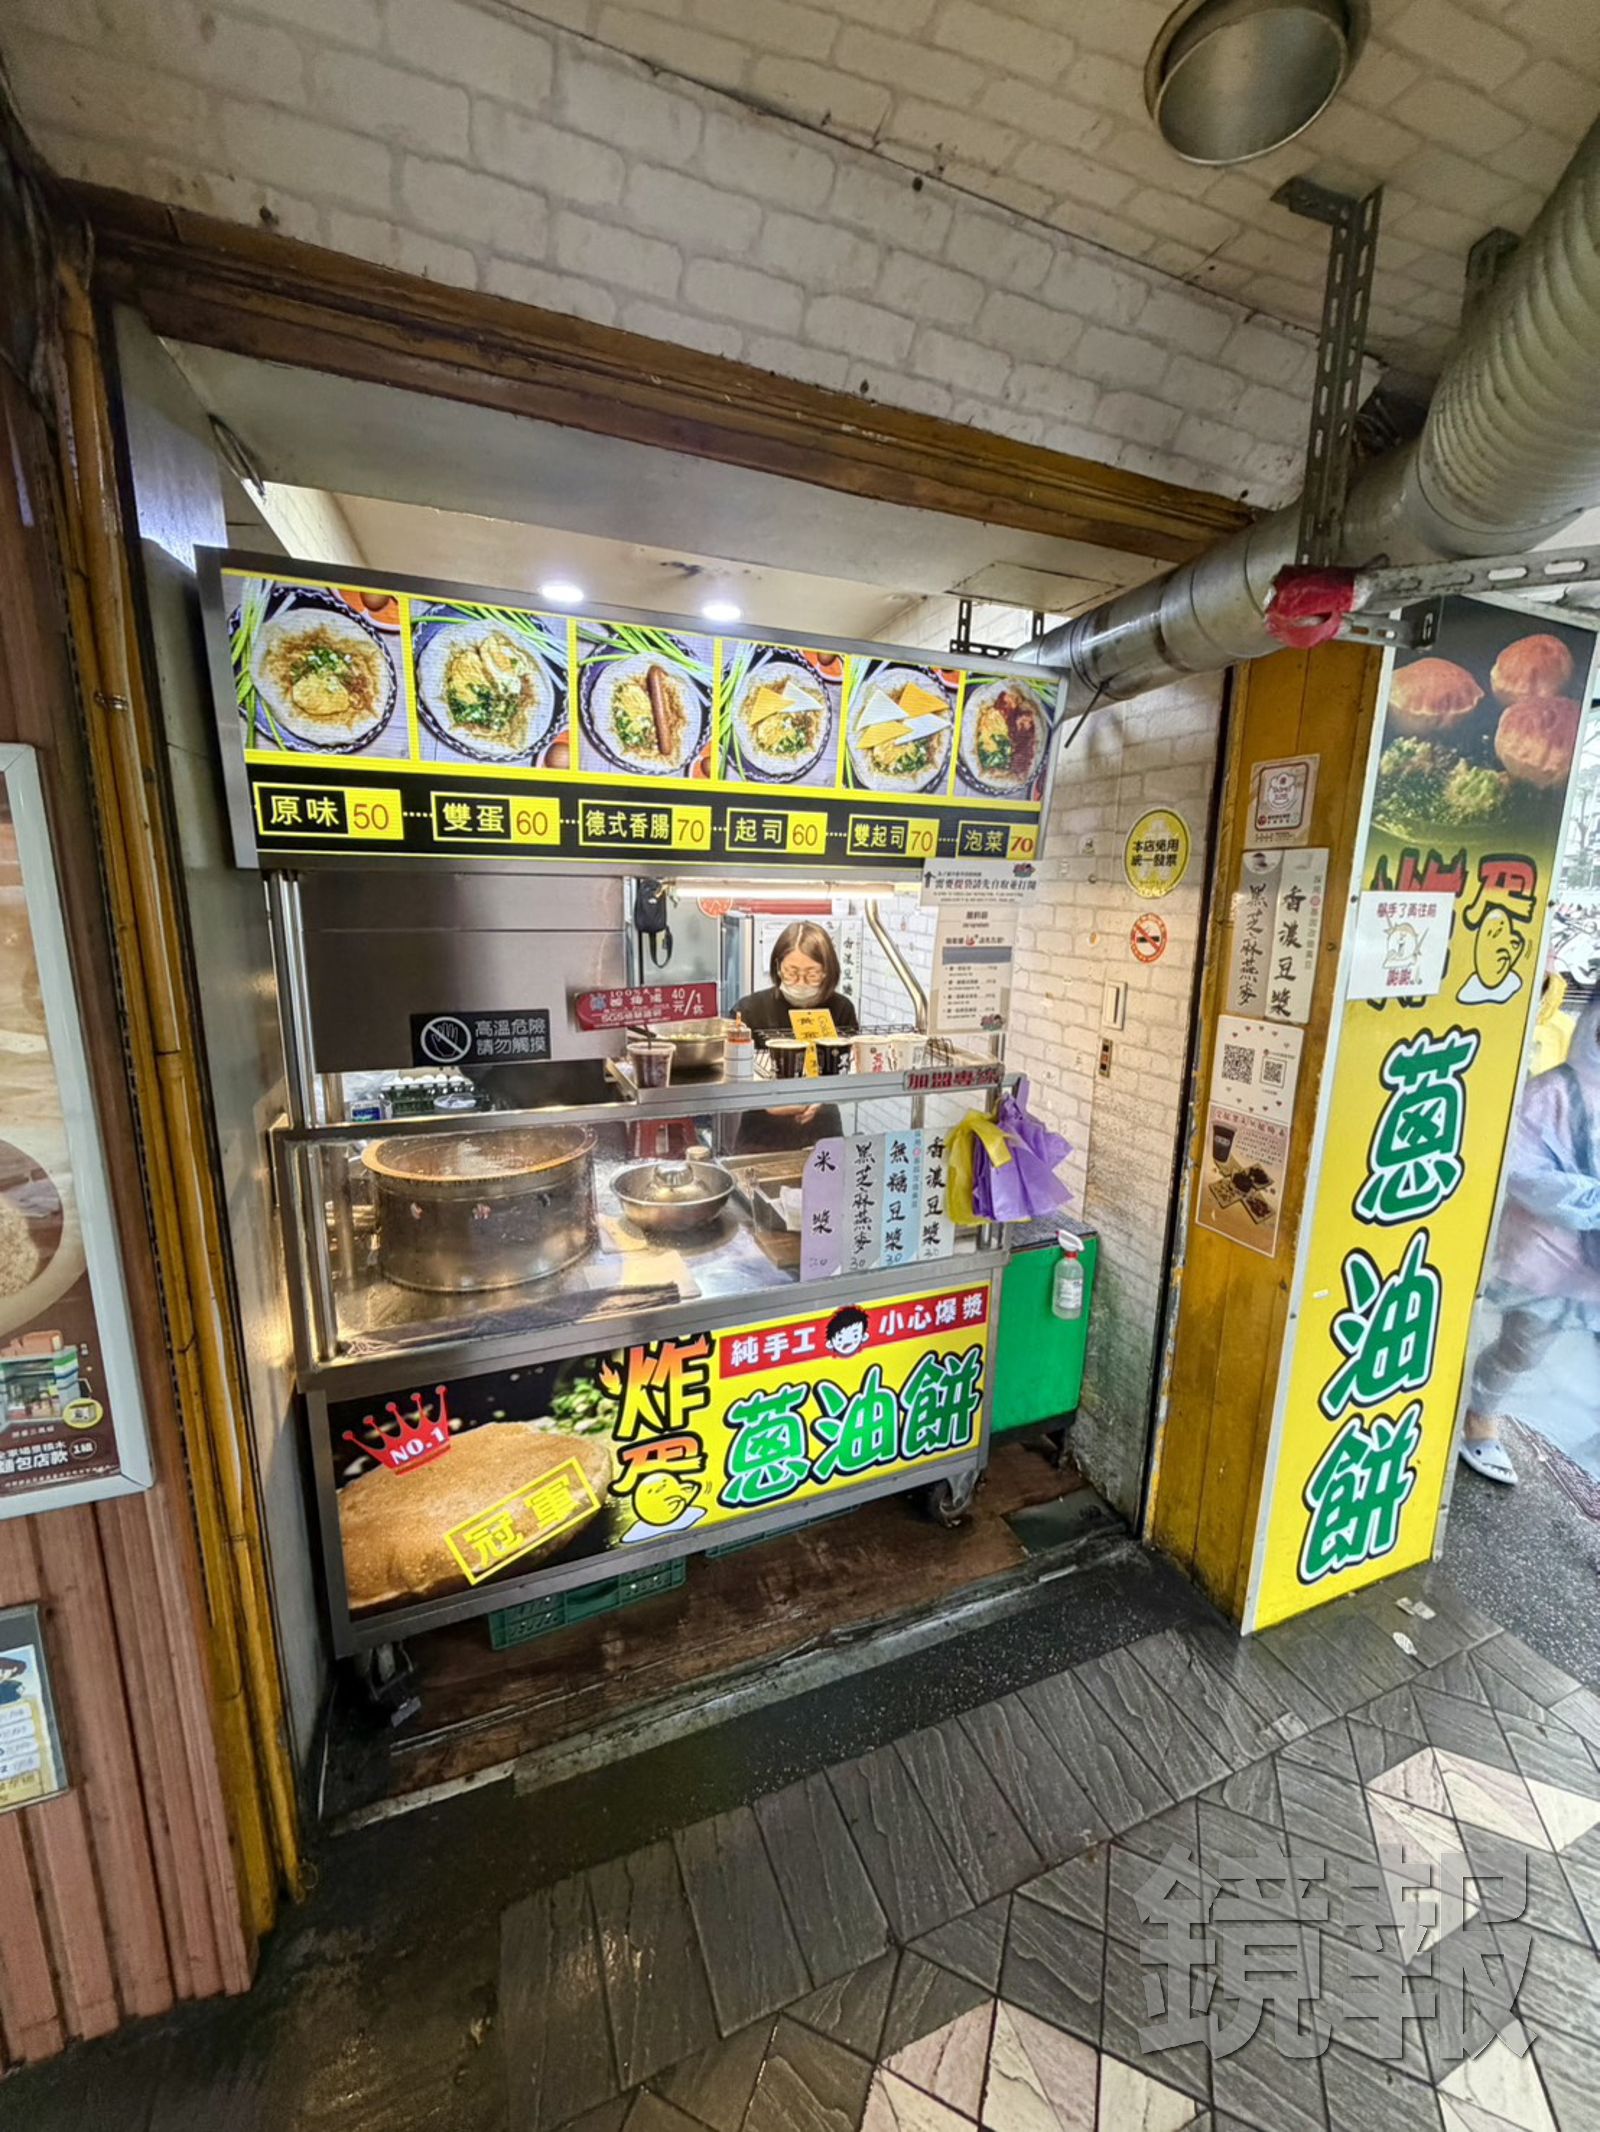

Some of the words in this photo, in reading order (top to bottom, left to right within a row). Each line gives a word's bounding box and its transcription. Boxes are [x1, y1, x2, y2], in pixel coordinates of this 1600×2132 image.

[270, 795, 340, 827] 原味
[353, 804, 389, 830] 50
[442, 802, 504, 833] 雙蛋
[516, 811, 548, 836] 60
[586, 810, 670, 840] 德式香腸
[677, 819, 706, 842] 70
[734, 817, 783, 844] 起司
[792, 824, 818, 847] 60
[853, 823, 905, 849] 雙起司
[910, 831, 934, 852] 70
[964, 829, 1003, 852] 泡菜
[1010, 836, 1034, 852] 70
[1271, 885, 1307, 1017] 香濃豆漿
[475, 1018, 547, 1037] 高溫危險
[476, 1036, 547, 1055] 請勿觸摸
[813, 1151, 837, 1235] 米漿
[885, 1140, 909, 1252] 無糖豆漿
[923, 1136, 947, 1246] 香濃豆漿
[731, 1327, 816, 1368] 純手工
[878, 1293, 983, 1336] 小心爆漿
[1297, 1026, 1480, 1584] 蔥油餅
[717, 1345, 983, 1507] 蔥油餅
[463, 1474, 582, 1568] 冠軍
